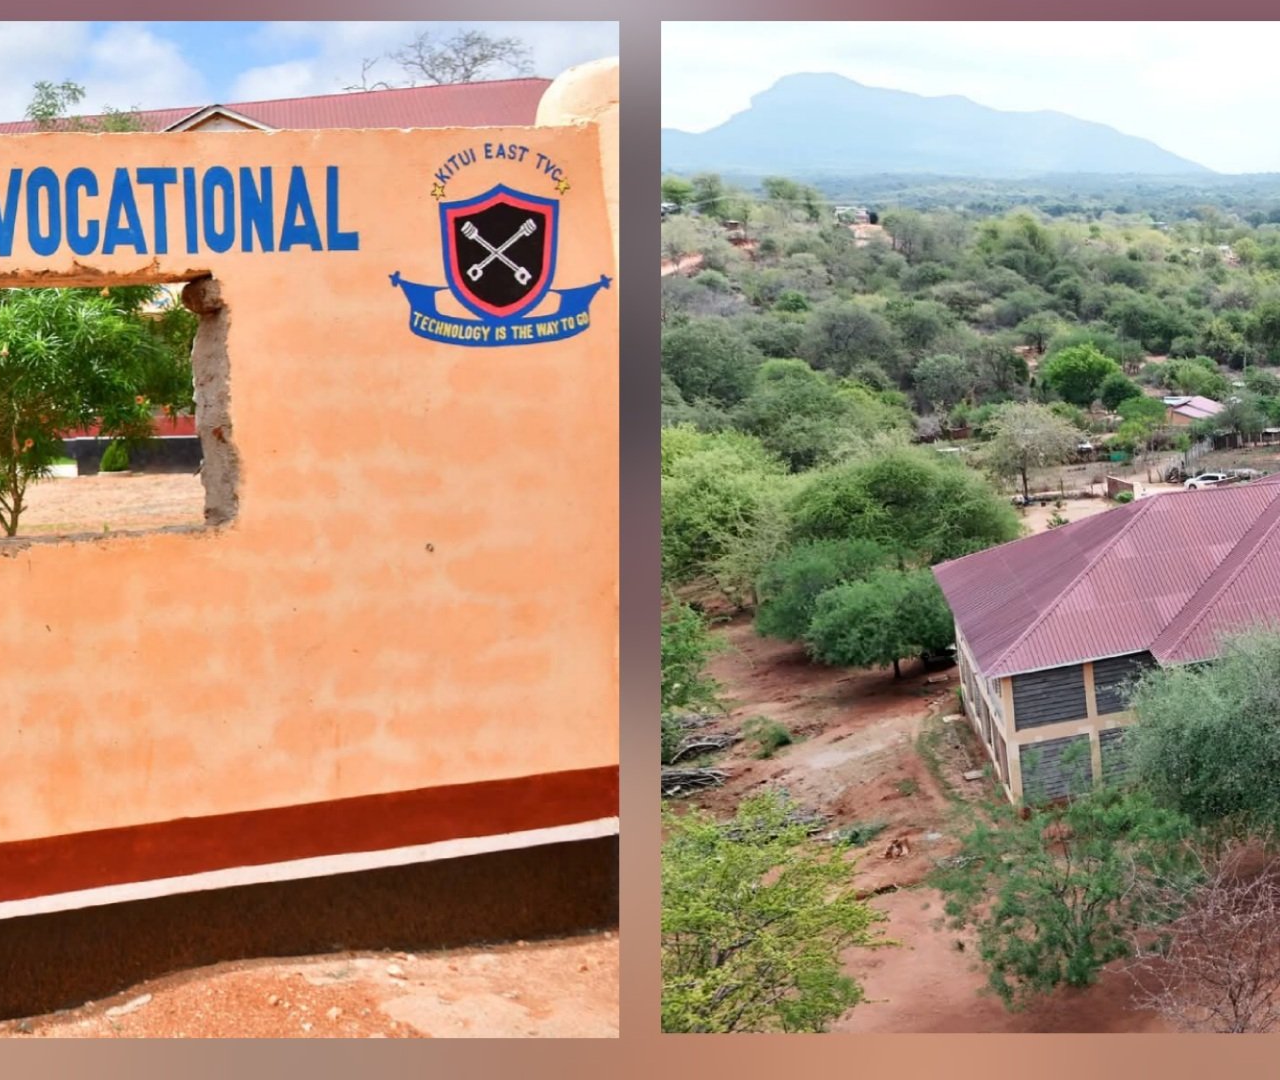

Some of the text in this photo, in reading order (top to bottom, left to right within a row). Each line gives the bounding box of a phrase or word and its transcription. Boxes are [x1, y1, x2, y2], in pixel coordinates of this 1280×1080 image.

[435, 143, 563, 185] KITUI EAST TVC
[413, 311, 489, 341] TECHNOLOGY
[495, 325, 506, 340] IS
[512, 324, 533, 339] THE
[536, 320, 560, 337] WAY
[562, 315, 576, 330] TO
